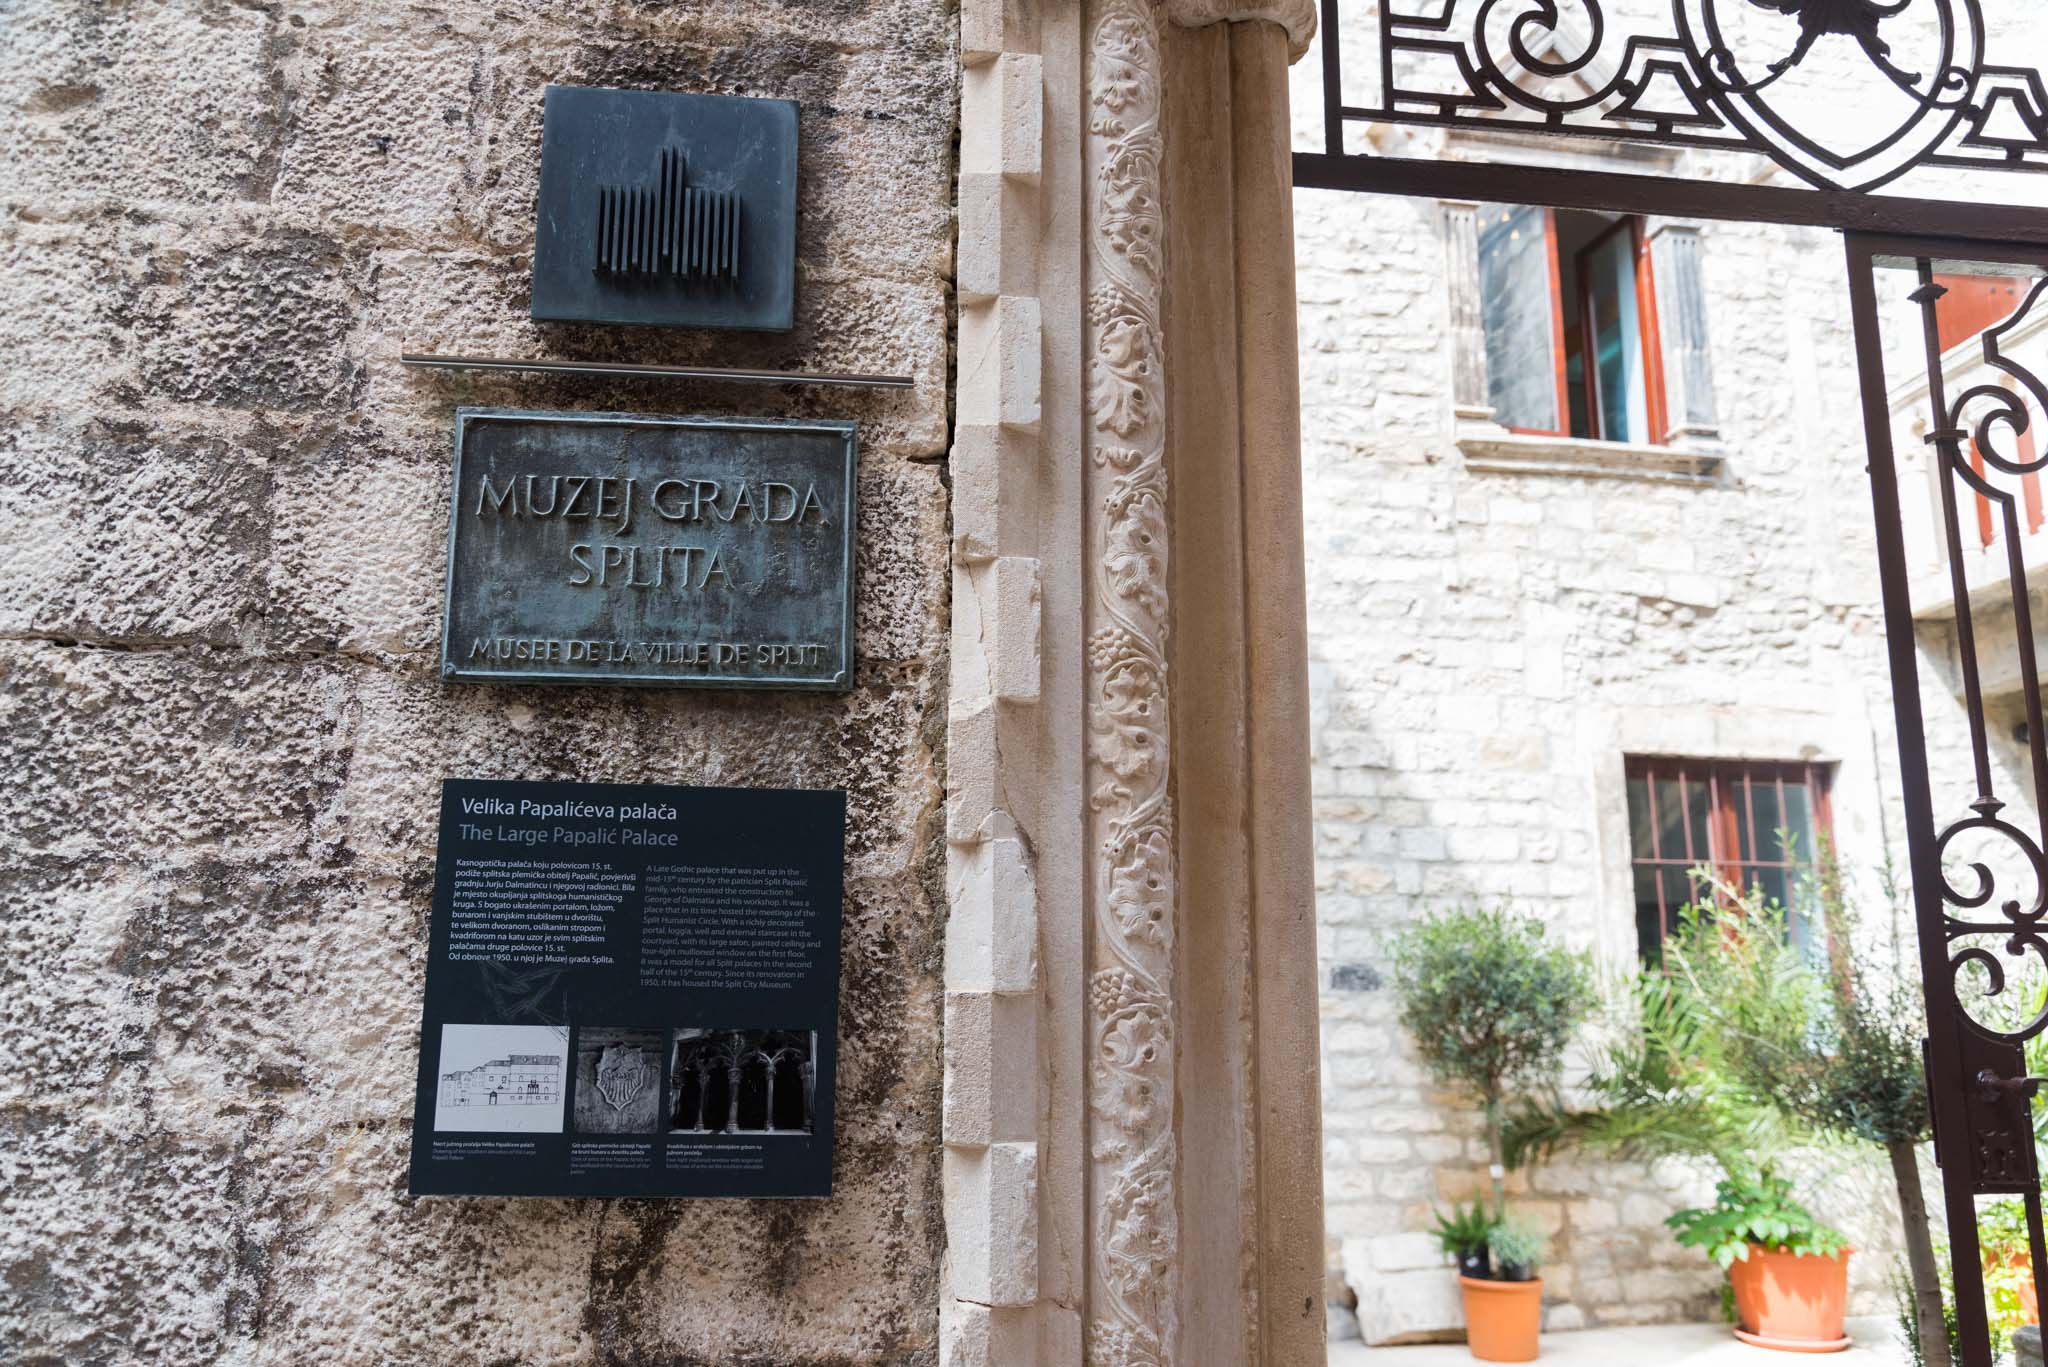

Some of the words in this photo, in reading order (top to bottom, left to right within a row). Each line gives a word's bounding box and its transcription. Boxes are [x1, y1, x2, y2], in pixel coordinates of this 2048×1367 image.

[476, 474, 636, 536] MUZEJ
[651, 479, 831, 525] GRADA
[569, 544, 735, 590] SPLITA
[468, 638, 559, 661] MUSEE
[567, 639, 597, 661] DE
[606, 641, 635, 662] LA
[641, 642, 708, 664] VILLE
[716, 643, 748, 664] DE
[757, 644, 826, 666] SPLIT
[462, 798, 514, 815] Velika
[521, 800, 614, 819] Papalićeva
[620, 803, 677, 822] palača
[460, 824, 492, 841] The
[498, 825, 548, 846] Large
[553, 827, 617, 847] Papalić
[622, 829, 678, 846] Palace
[455, 858, 506, 869] Kasnogotička
[507, 860, 532, 870] palača
[532, 860, 549, 870] koju
[550, 861, 590, 871] polovicom
[454, 869, 481, 879] podiže
[481, 870, 510, 880] splitska
[511, 870, 545, 880] plemićka
[546, 871, 570, 881] obitelj
[600, 873, 636, 883] povjerivši
[454, 879, 484, 889] gradnju
[484, 880, 503, 890] Jurju
[504, 881, 548, 889] Dalmatincu
[552, 882, 585, 892] njegovoj
[621, 884, 635, 892] Bila
[453, 890, 461, 899] je
[461, 890, 488, 900] mjesto
[488, 891, 528, 901] okupljanja
[529, 892, 567, 902] splitskoga
[567, 893, 622, 903] humanističkog
[483, 901, 511, 911] bogato
[512, 902, 551, 910] ukrašenim
[451, 910, 486, 919] bunarom
[487, 911, 491, 919] i
[491, 912, 525, 922] vanjskim
[526, 912, 563, 921] stubištem
[450, 921, 459, 929] te
[460, 921, 490, 929] velikom
[532, 923, 569, 931] oslikanim
[569, 924, 602, 934] stropom
[449, 931, 496, 940] kvadriforom
[508, 933, 525, 941] katu
[544, 934, 551, 943] je
[552, 934, 570, 942] svim
[571, 935, 605, 945] splitskim
[448, 942, 486, 952] palačama
[486, 943, 510, 952] druge
[510, 943, 542, 953] polovice
[448, 952, 460, 960] Od
[520, 954, 535, 964] njoj
[535, 954, 543, 964] je
